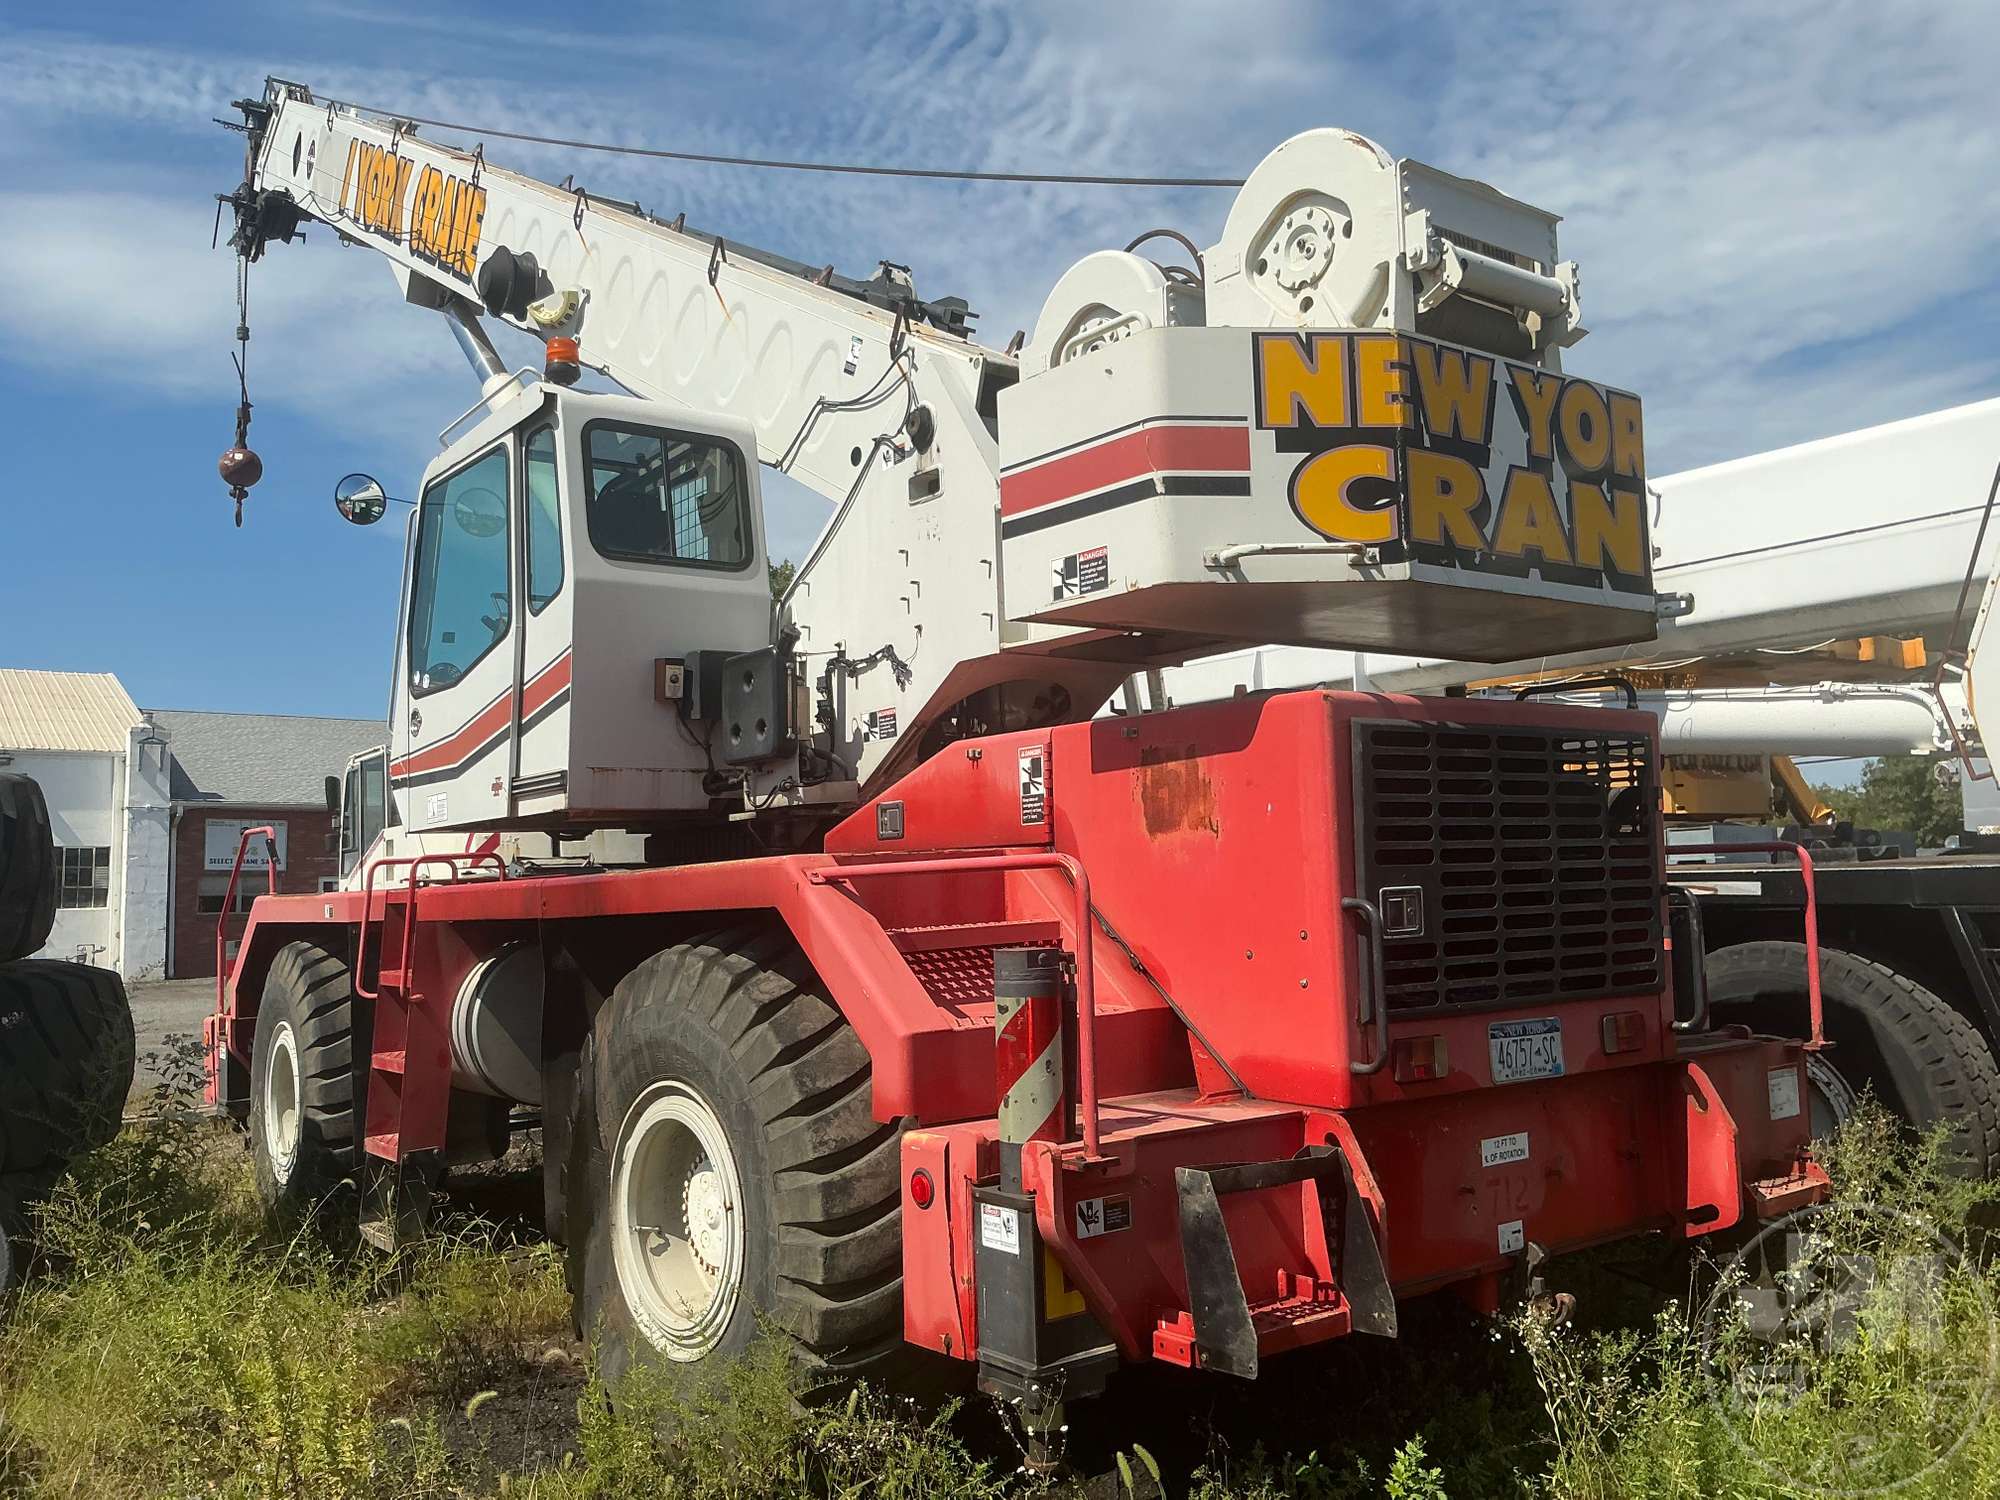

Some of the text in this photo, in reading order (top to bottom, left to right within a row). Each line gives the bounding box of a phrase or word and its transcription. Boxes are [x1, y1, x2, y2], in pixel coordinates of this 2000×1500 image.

[409, 163, 487, 284] CRANE
[1253, 332, 1495, 445] NEW
[209, 857, 233, 865] SELECT
[1499, 1148, 1526, 1161] ROTATION
